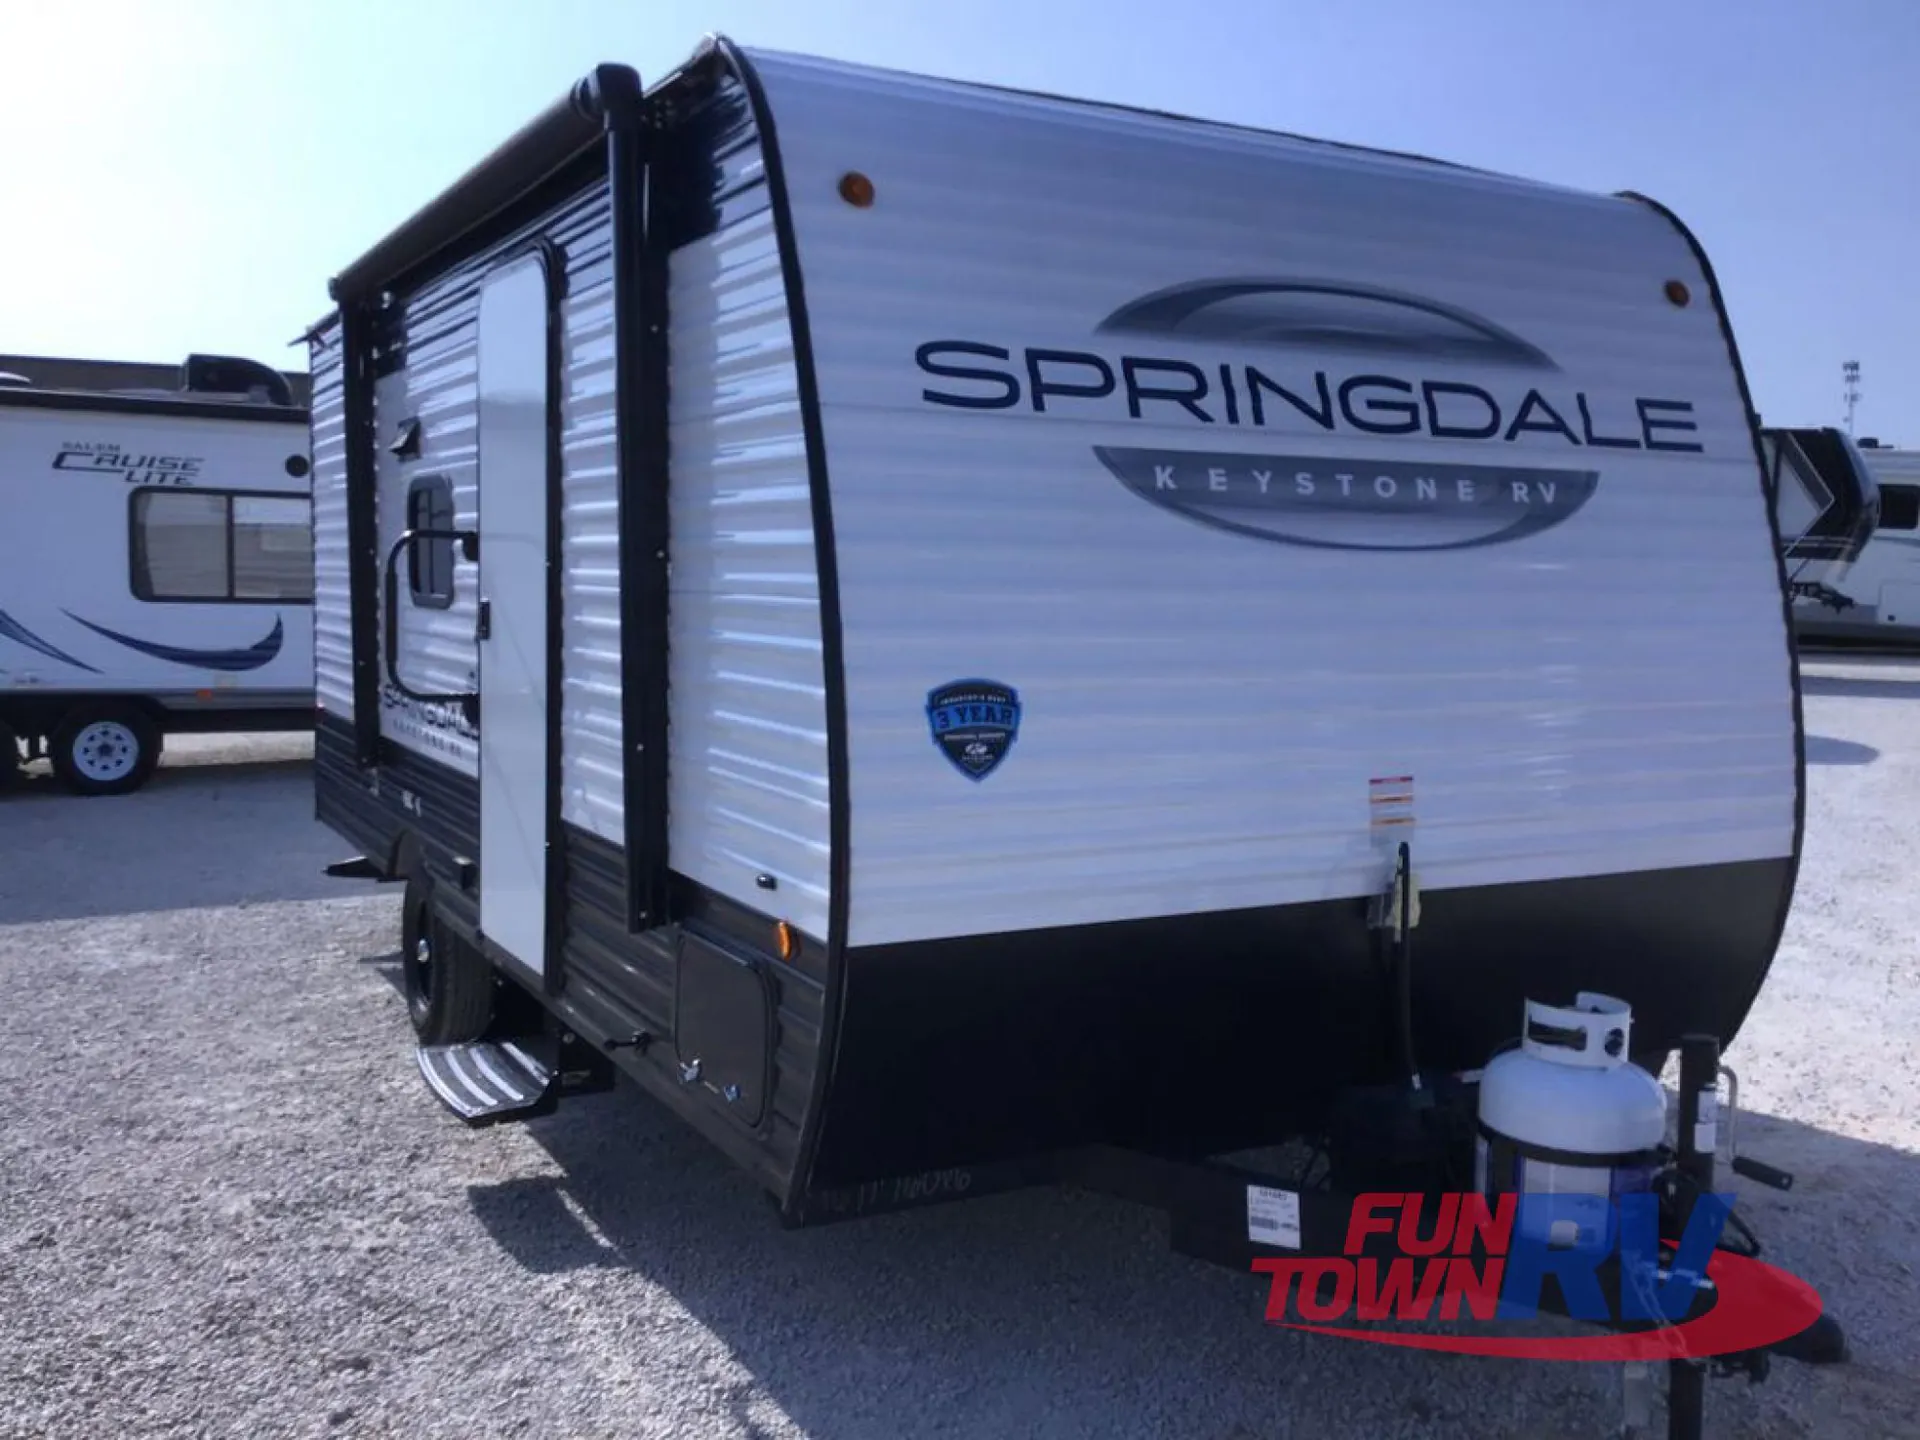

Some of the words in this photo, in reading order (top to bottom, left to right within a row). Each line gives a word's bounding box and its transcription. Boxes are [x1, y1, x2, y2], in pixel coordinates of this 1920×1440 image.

[914, 339, 1704, 453] SPRINGDALE
[52, 451, 206, 473] CRUISE
[123, 469, 197, 485] LITE
[1154, 464, 1476, 503] KEYSTONE
[1512, 480, 1557, 503] RV
